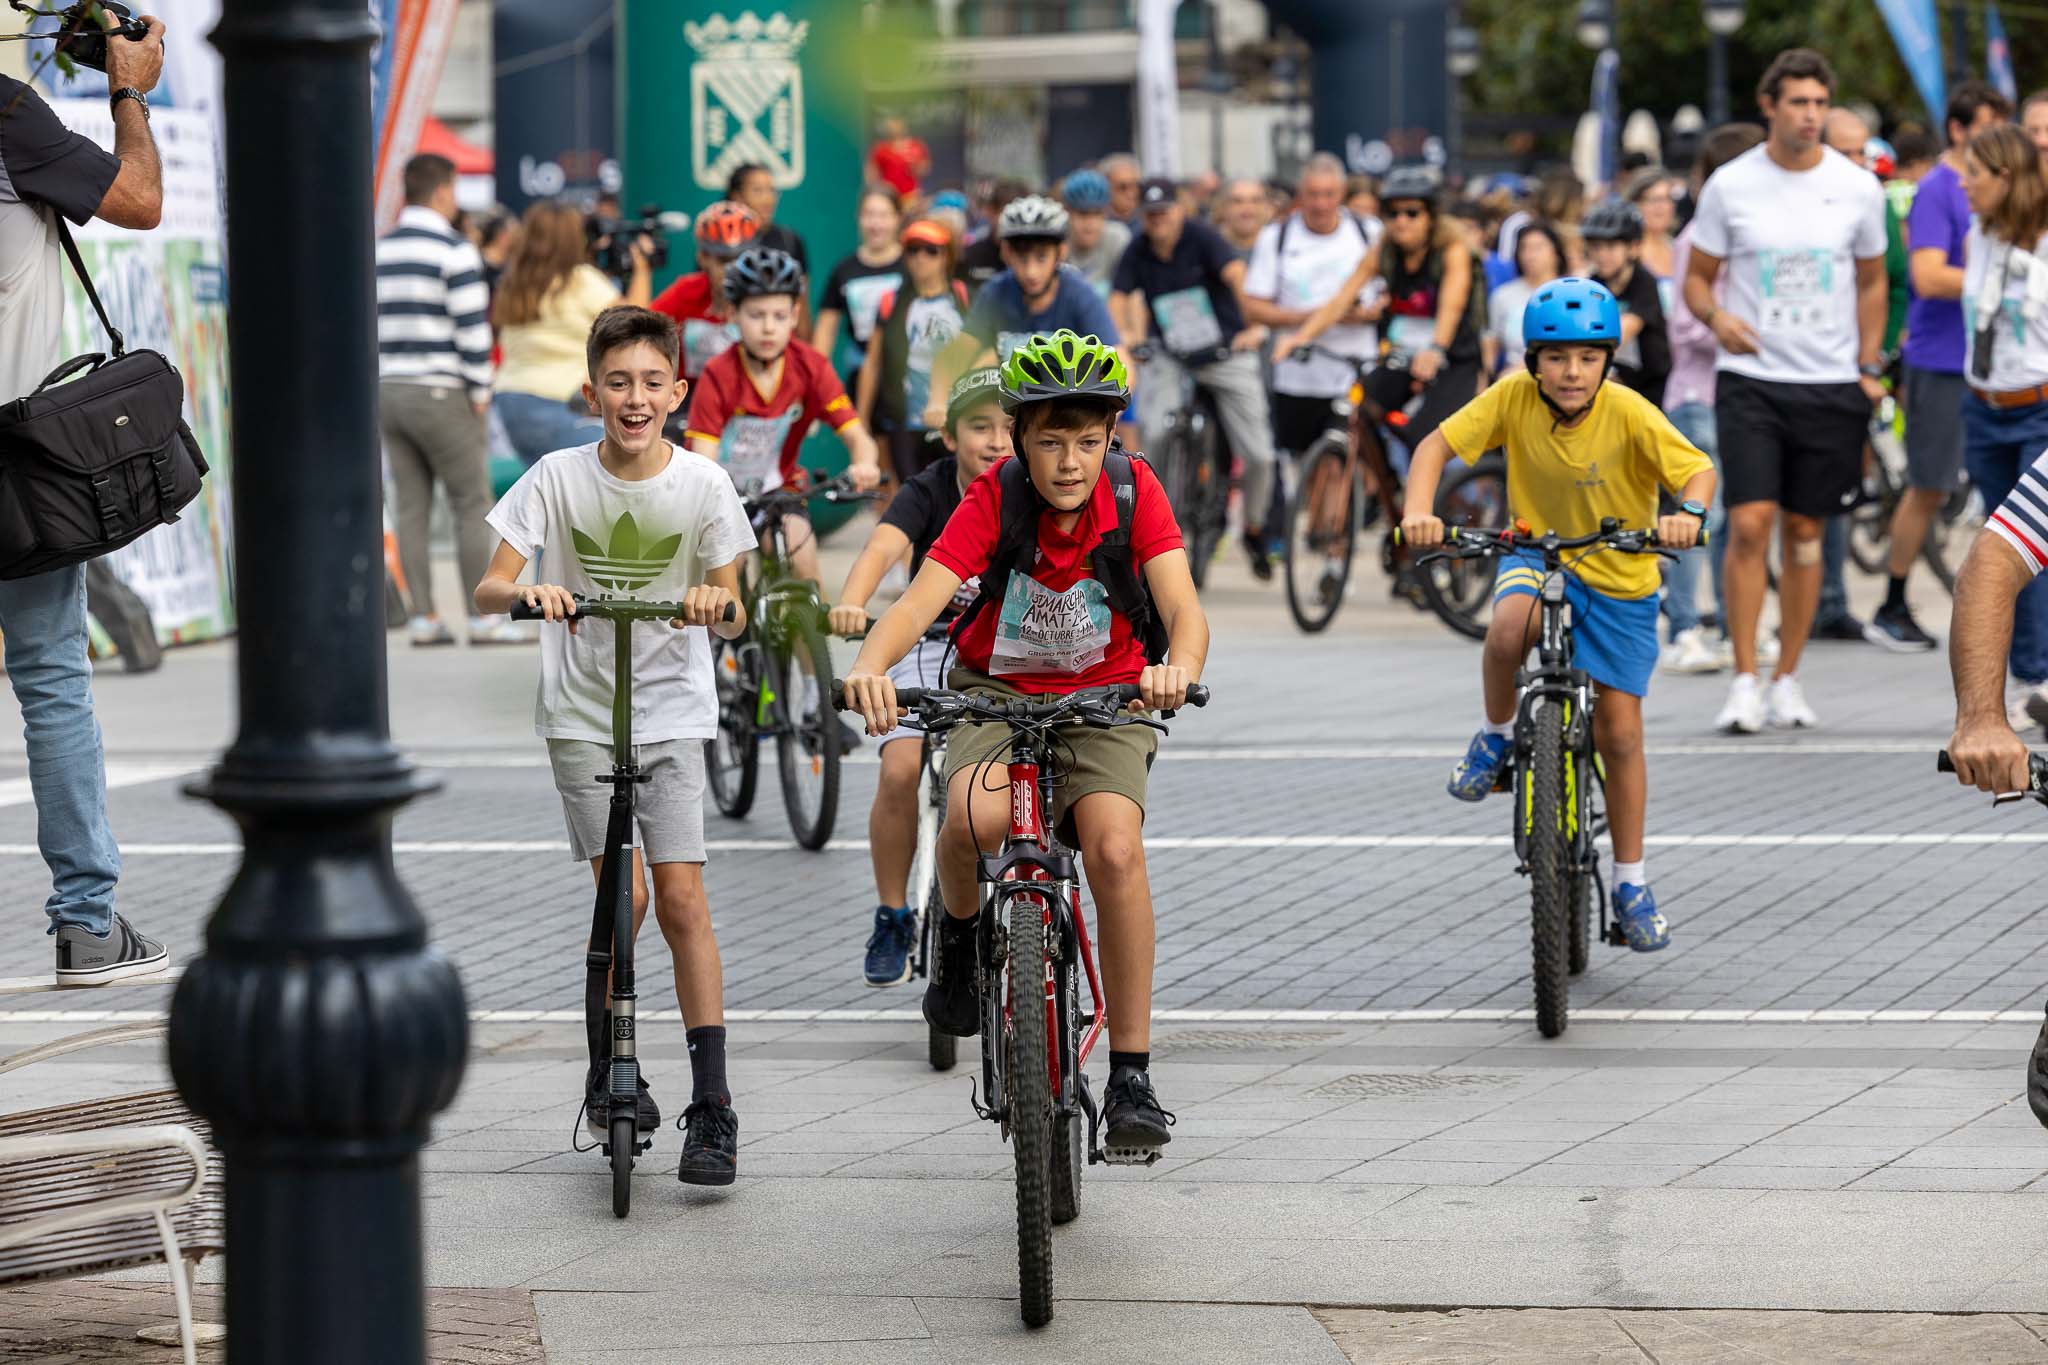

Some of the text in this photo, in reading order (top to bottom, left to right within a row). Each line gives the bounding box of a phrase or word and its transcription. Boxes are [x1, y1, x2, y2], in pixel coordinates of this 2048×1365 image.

[1038, 589, 1084, 613] MARCHA
[1021, 624, 1031, 635] 12
[1038, 629, 1074, 640] OCTUBRE
